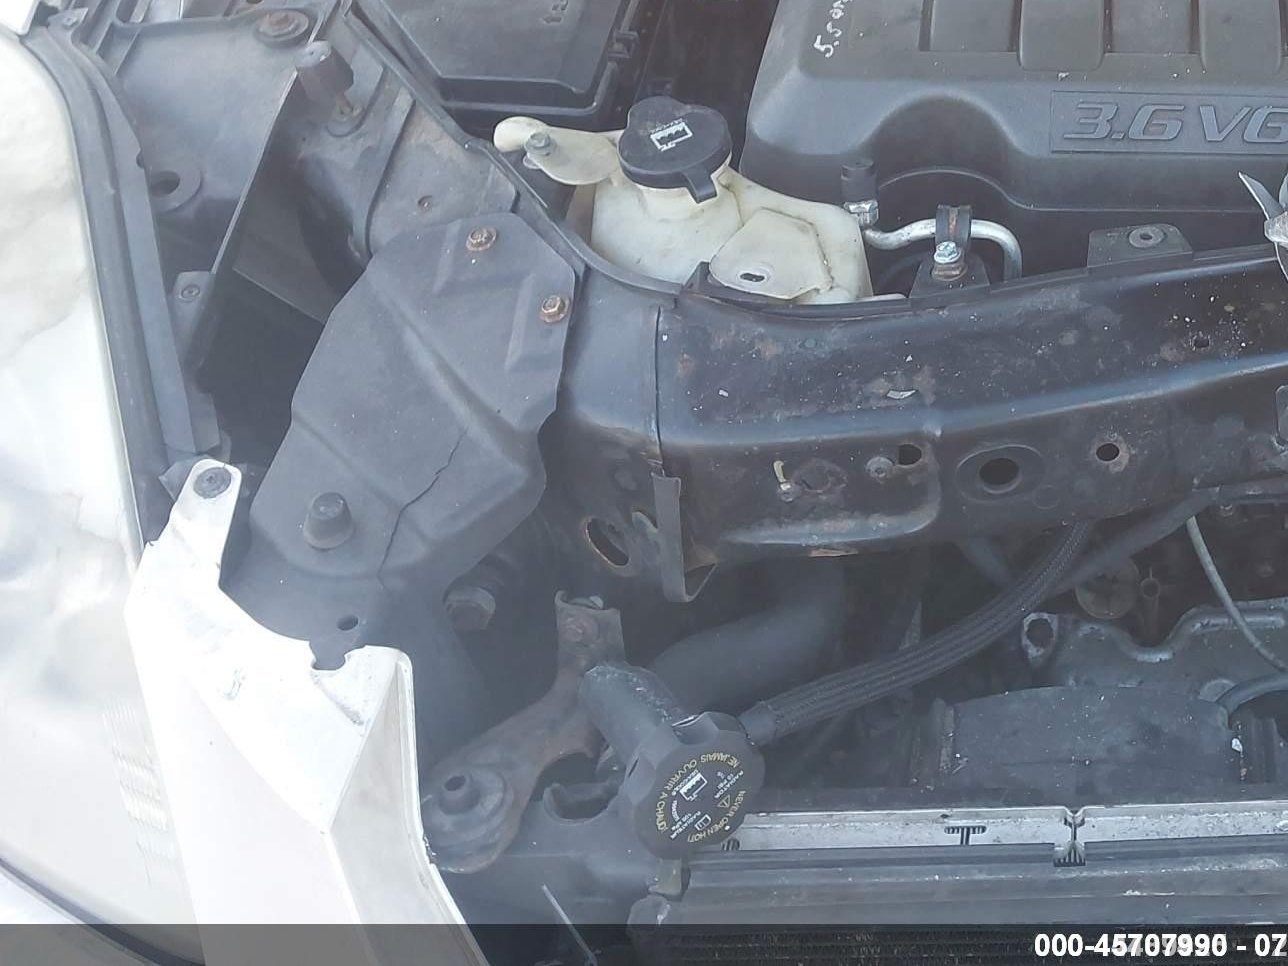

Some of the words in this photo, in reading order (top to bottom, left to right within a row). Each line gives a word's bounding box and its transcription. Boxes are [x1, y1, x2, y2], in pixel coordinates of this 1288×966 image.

[1063, 102, 1185, 141] 3.6
[700, 752, 730, 763] JAMAIS
[664, 759, 697, 791] OUVRIR
[728, 790, 746, 817] NEVER
[706, 816, 729, 835] OPEN
